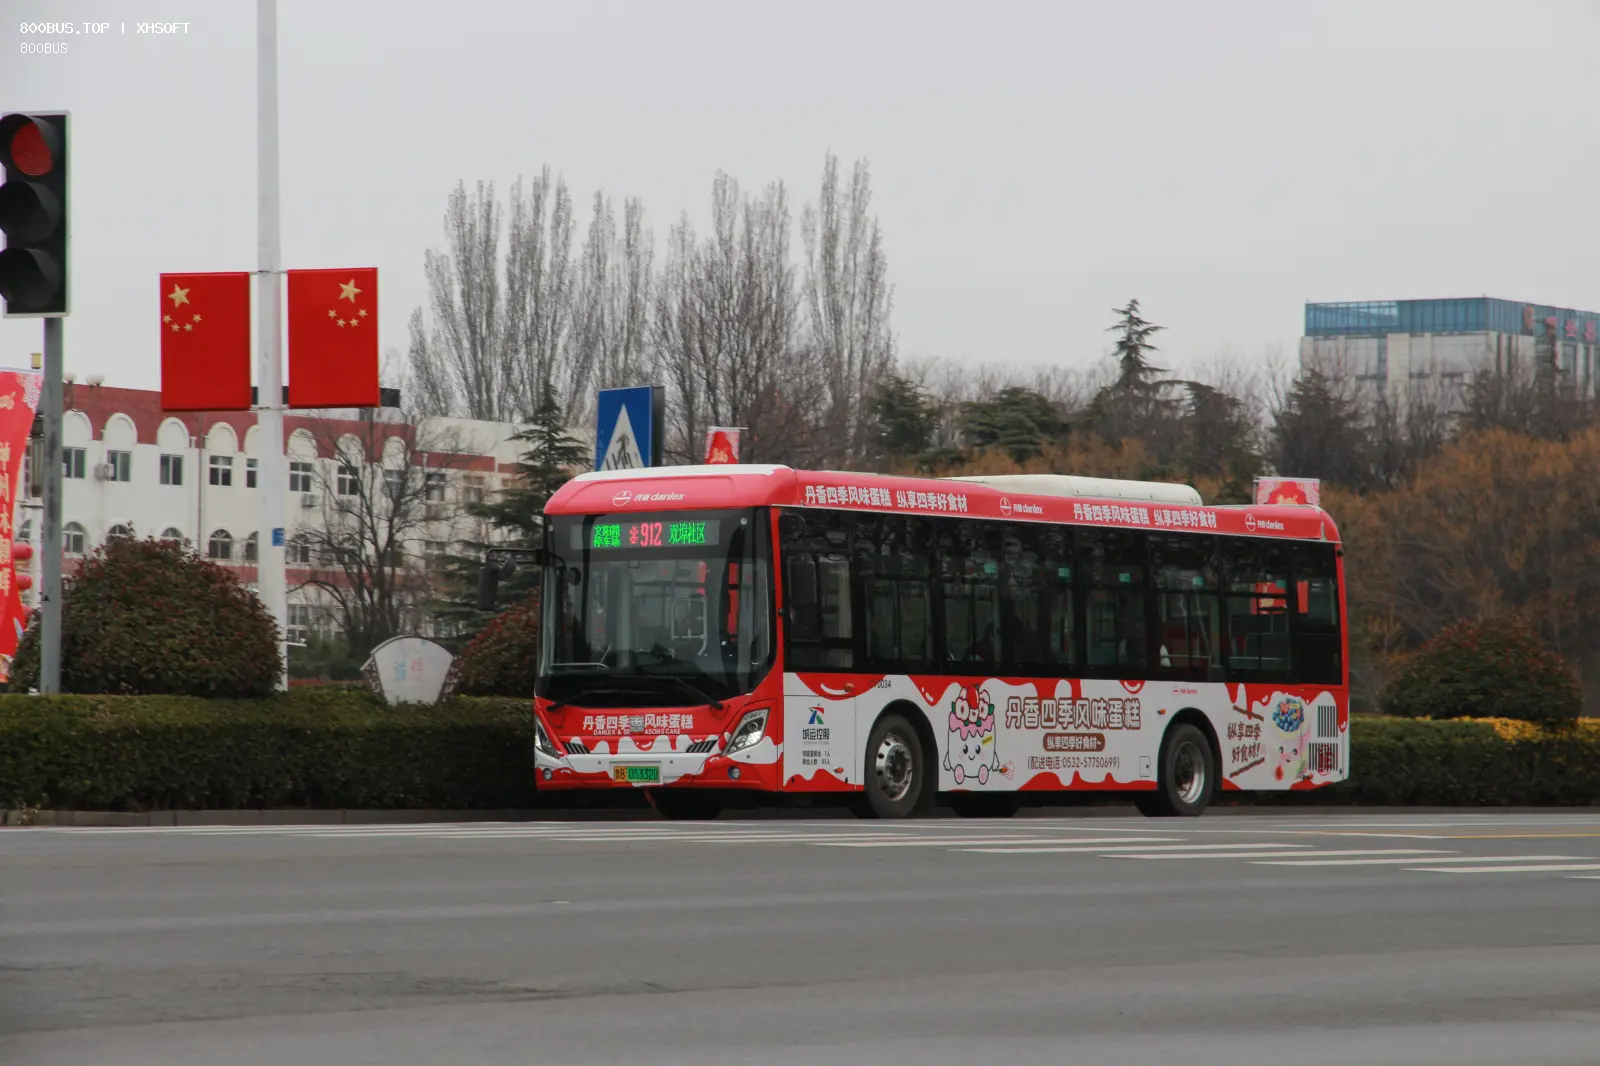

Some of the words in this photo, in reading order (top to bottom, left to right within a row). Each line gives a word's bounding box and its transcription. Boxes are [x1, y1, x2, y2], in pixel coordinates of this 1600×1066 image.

[650, 492, 685, 501] danlex
[804, 485, 893, 507] 丹香四季风味蛋糕
[896, 490, 968, 512] 纵享四季好食材
[1073, 503, 1150, 525] 丹香四季风味蛋糕
[1153, 509, 1217, 529] 纵享四季好食材
[640, 522, 662, 546] 912
[583, 715, 630, 730] 丹香四季
[644, 713, 694, 729] 风味蛋糕
[1005, 696, 1141, 730] 丹香四季风味蛋糕
[802, 728, 830, 740] 城运控股
[1227, 722, 1262, 740] 纵享四季
